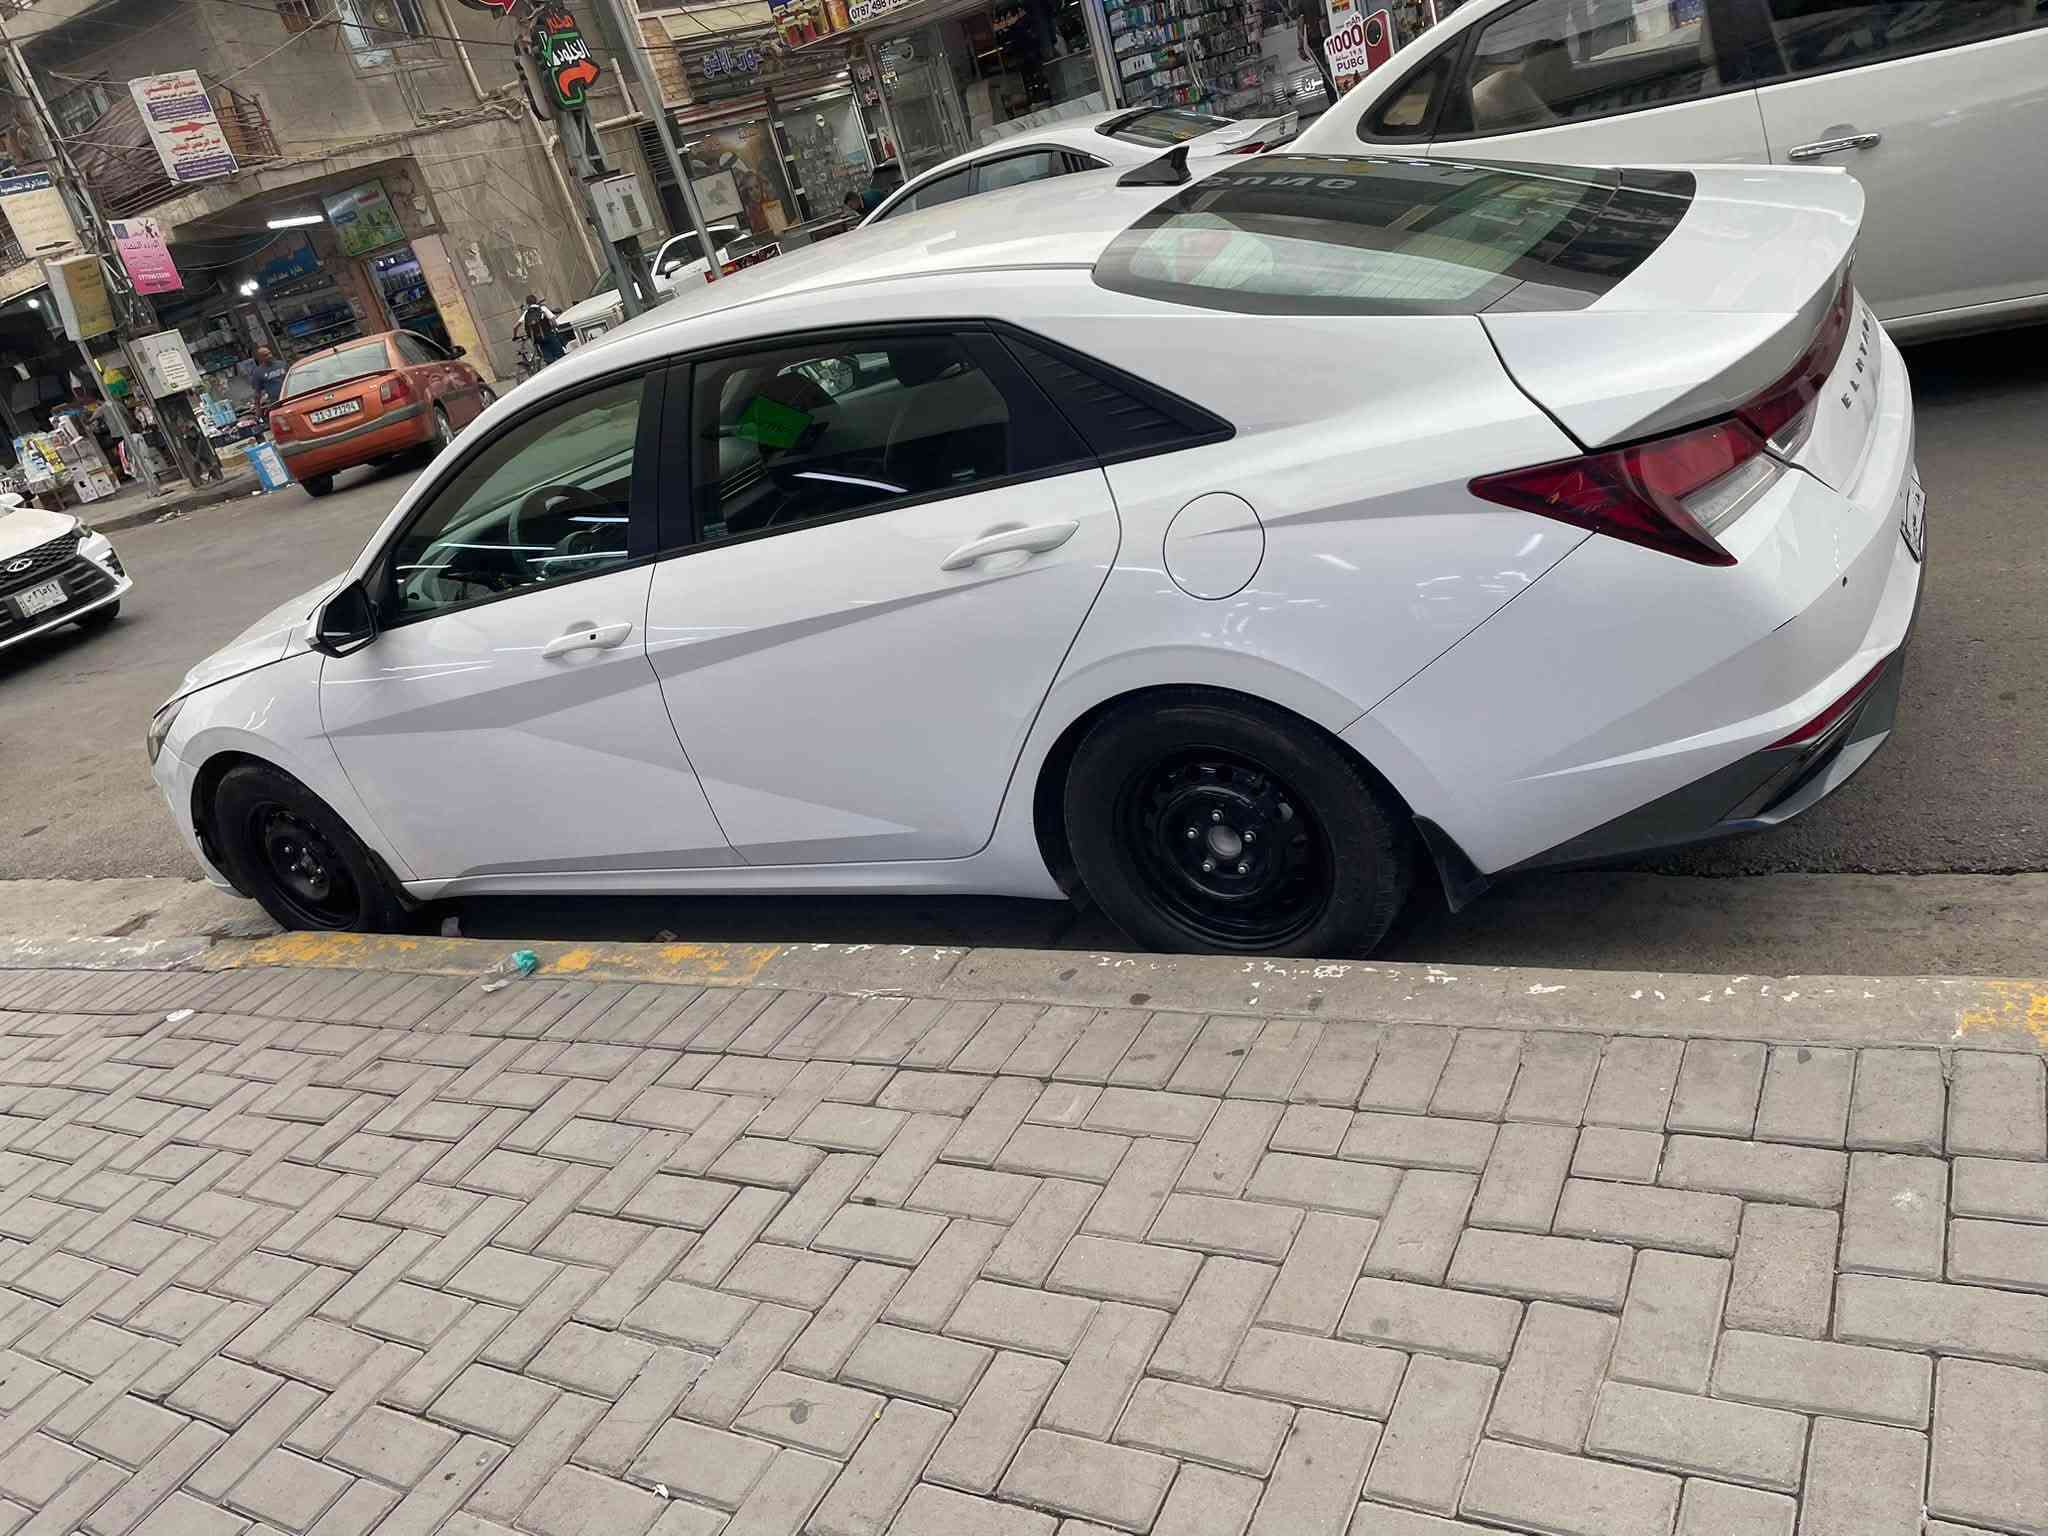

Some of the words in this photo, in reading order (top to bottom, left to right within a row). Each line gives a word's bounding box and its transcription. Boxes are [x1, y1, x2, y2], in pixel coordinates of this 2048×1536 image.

[851, 4, 870, 20] 0787
[1326, 24, 1363, 55] 11000
[1336, 56, 1365, 72] PUBG
